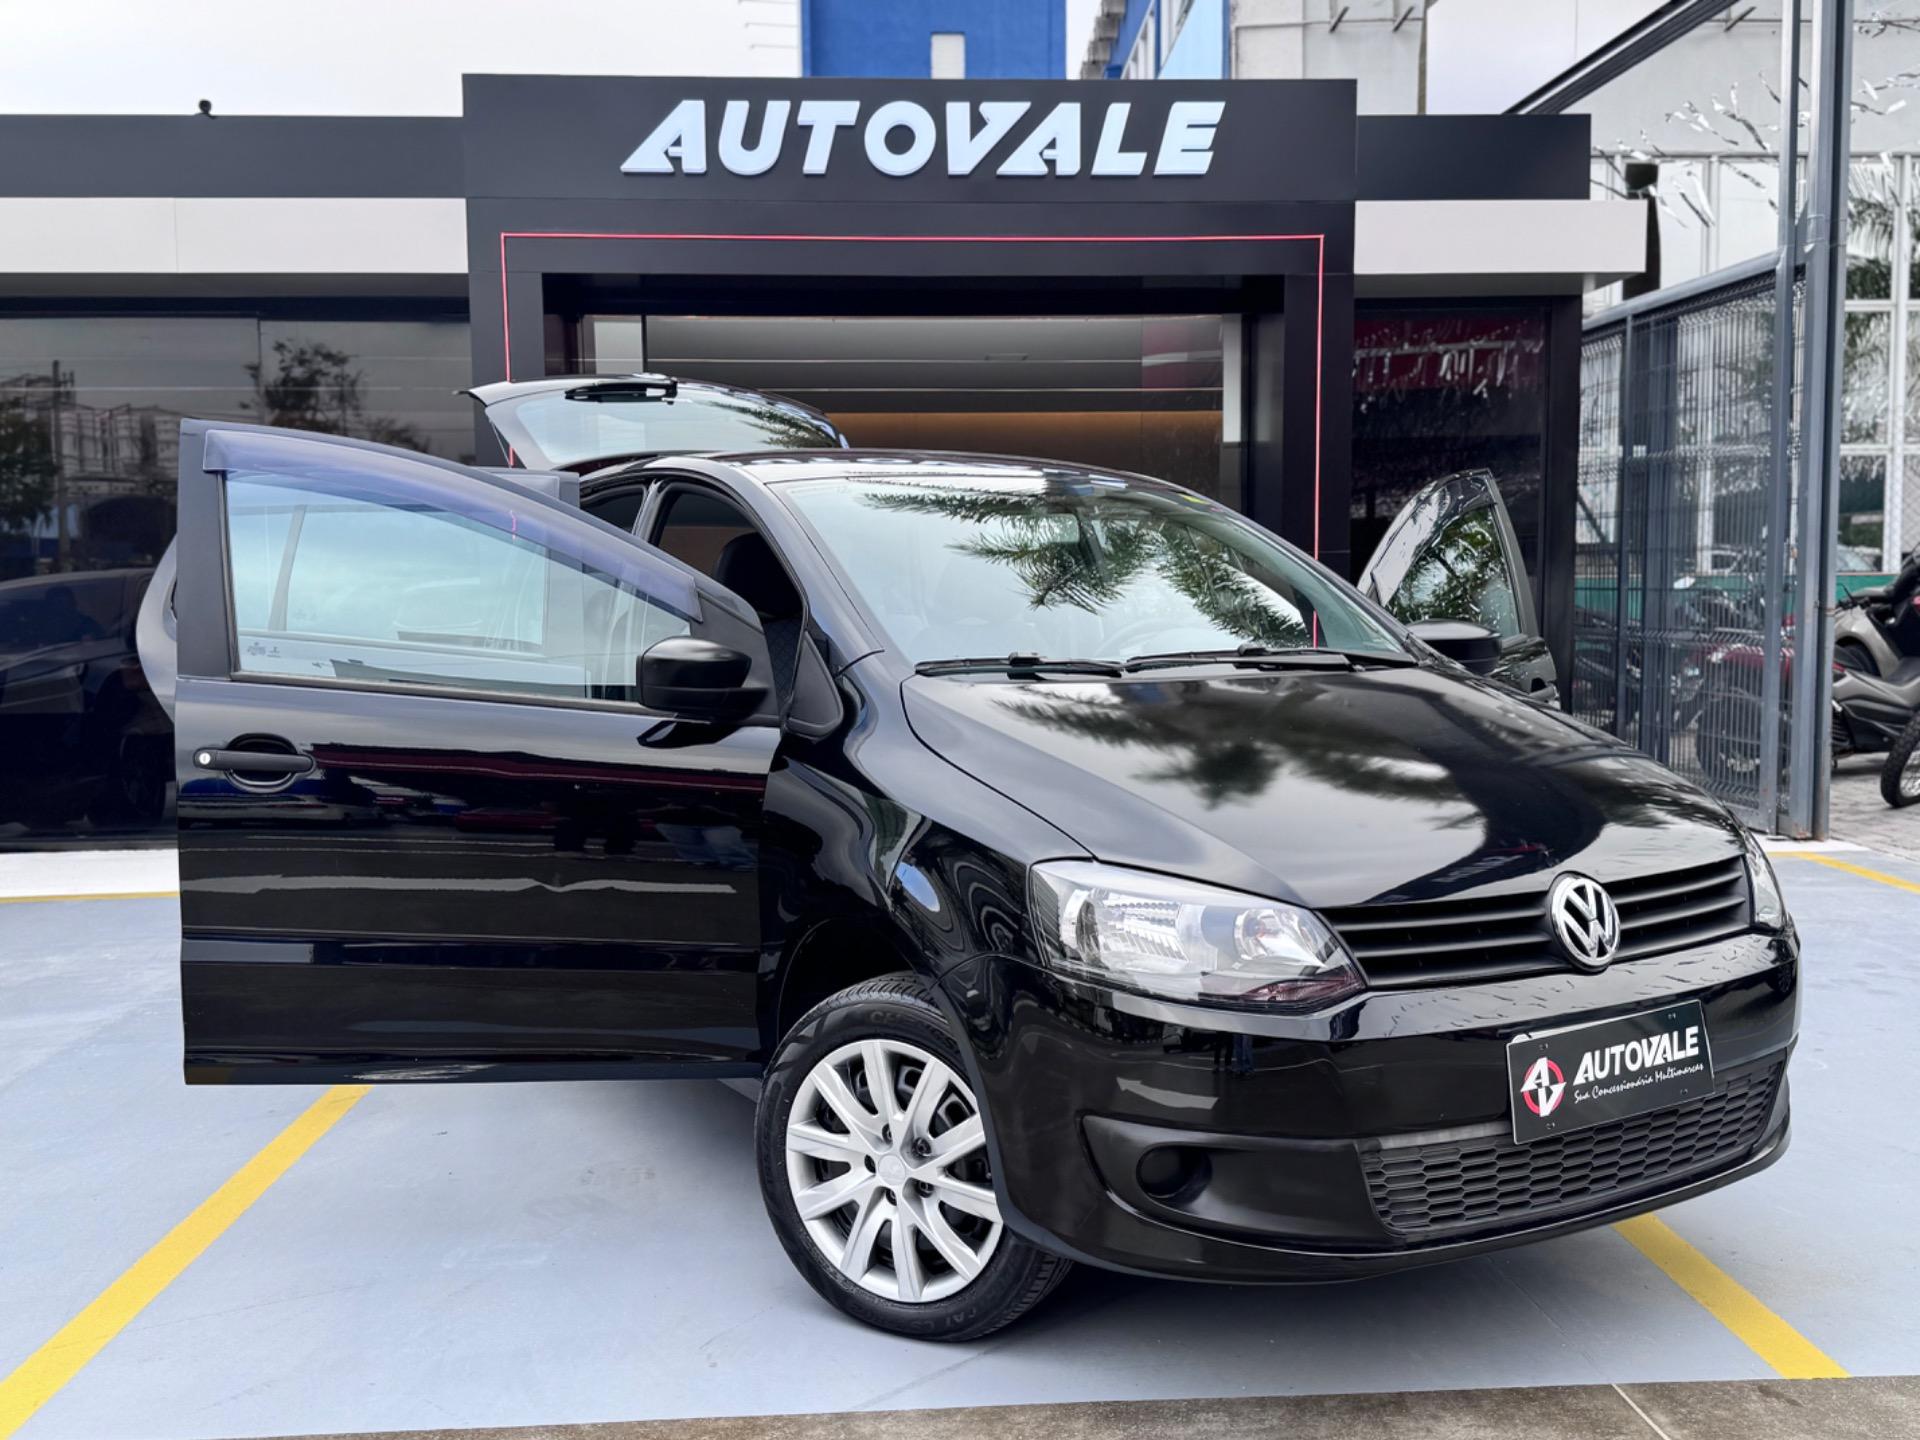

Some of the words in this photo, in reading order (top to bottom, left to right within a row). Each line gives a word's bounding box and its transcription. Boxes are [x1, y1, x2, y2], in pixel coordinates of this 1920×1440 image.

[620, 100, 1226, 176] AUTOVALE
[1573, 1025, 1699, 1086] AUTOVALE
[1574, 1090, 1590, 1104] Sua
[1654, 1063, 1704, 1083] Multimarcas
